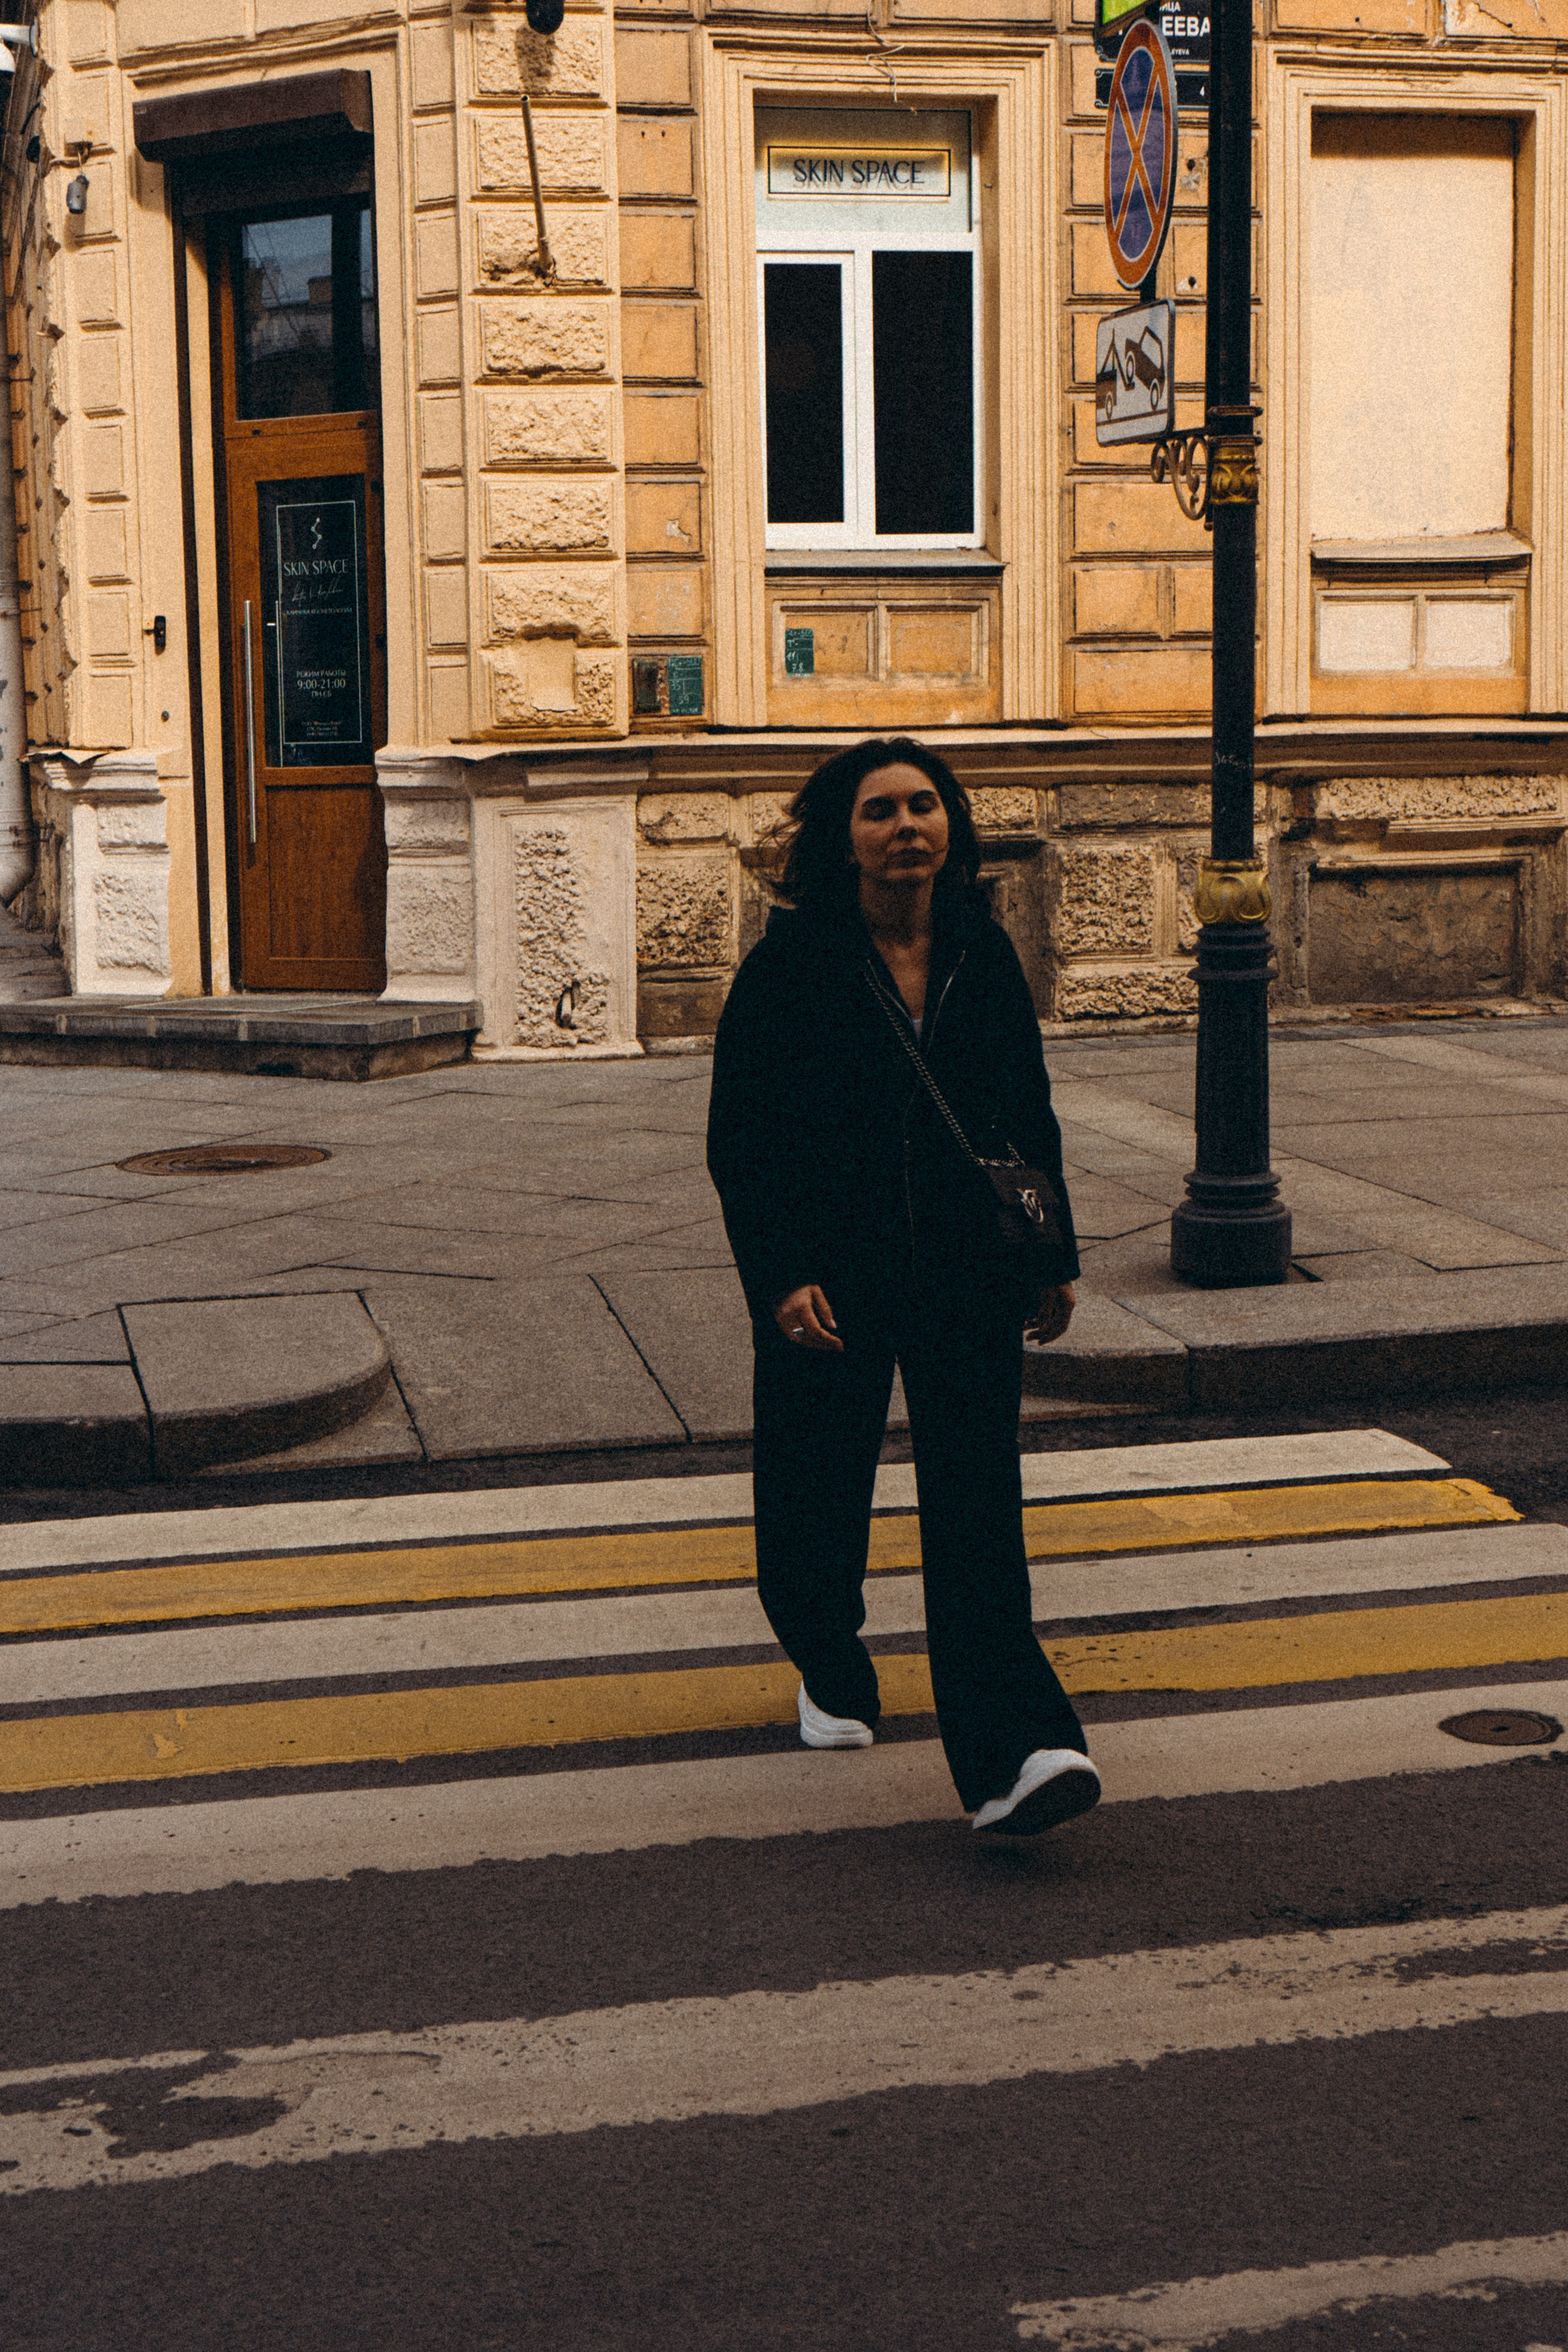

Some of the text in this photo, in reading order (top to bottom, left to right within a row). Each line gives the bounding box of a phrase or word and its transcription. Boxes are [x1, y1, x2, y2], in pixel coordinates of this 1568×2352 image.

[794, 158, 925, 184] SKIN SPACE
[284, 559, 349, 576] SKIN SPACE
[297, 678, 346, 690] 9:00-21:00
